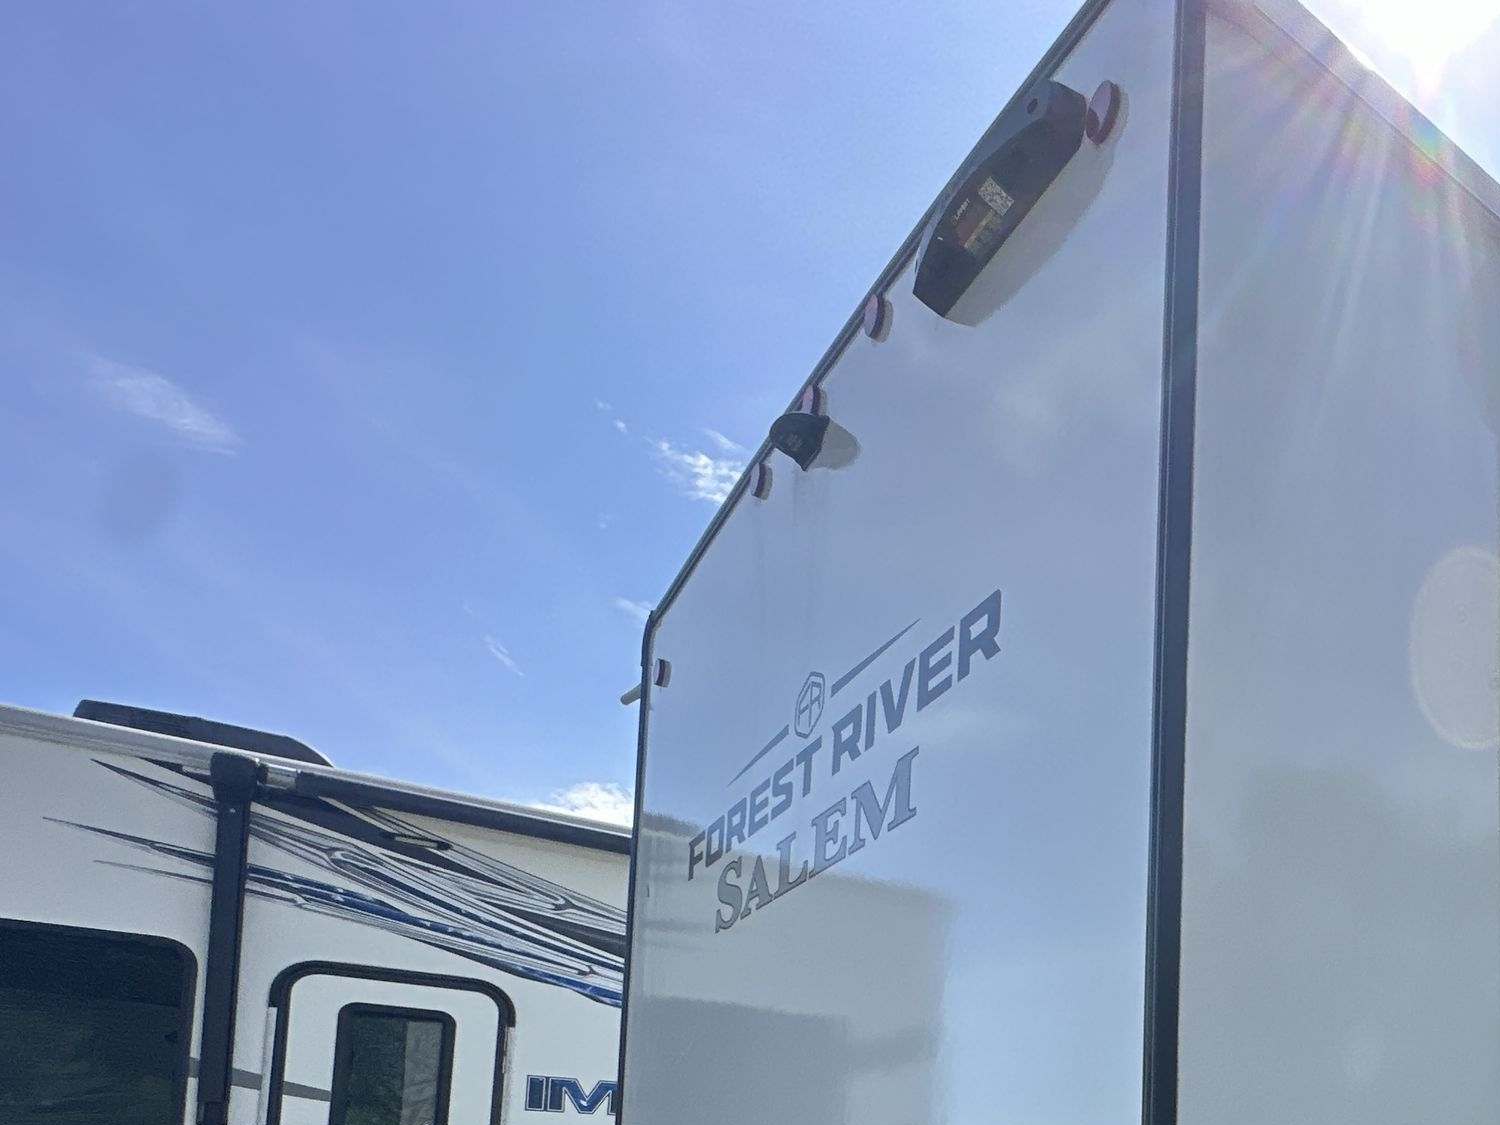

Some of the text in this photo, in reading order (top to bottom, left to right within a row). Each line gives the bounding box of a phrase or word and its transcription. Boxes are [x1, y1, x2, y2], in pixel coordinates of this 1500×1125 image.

[687, 588, 1002, 882] FOREST RIVER
[714, 745, 920, 934] SALEM
